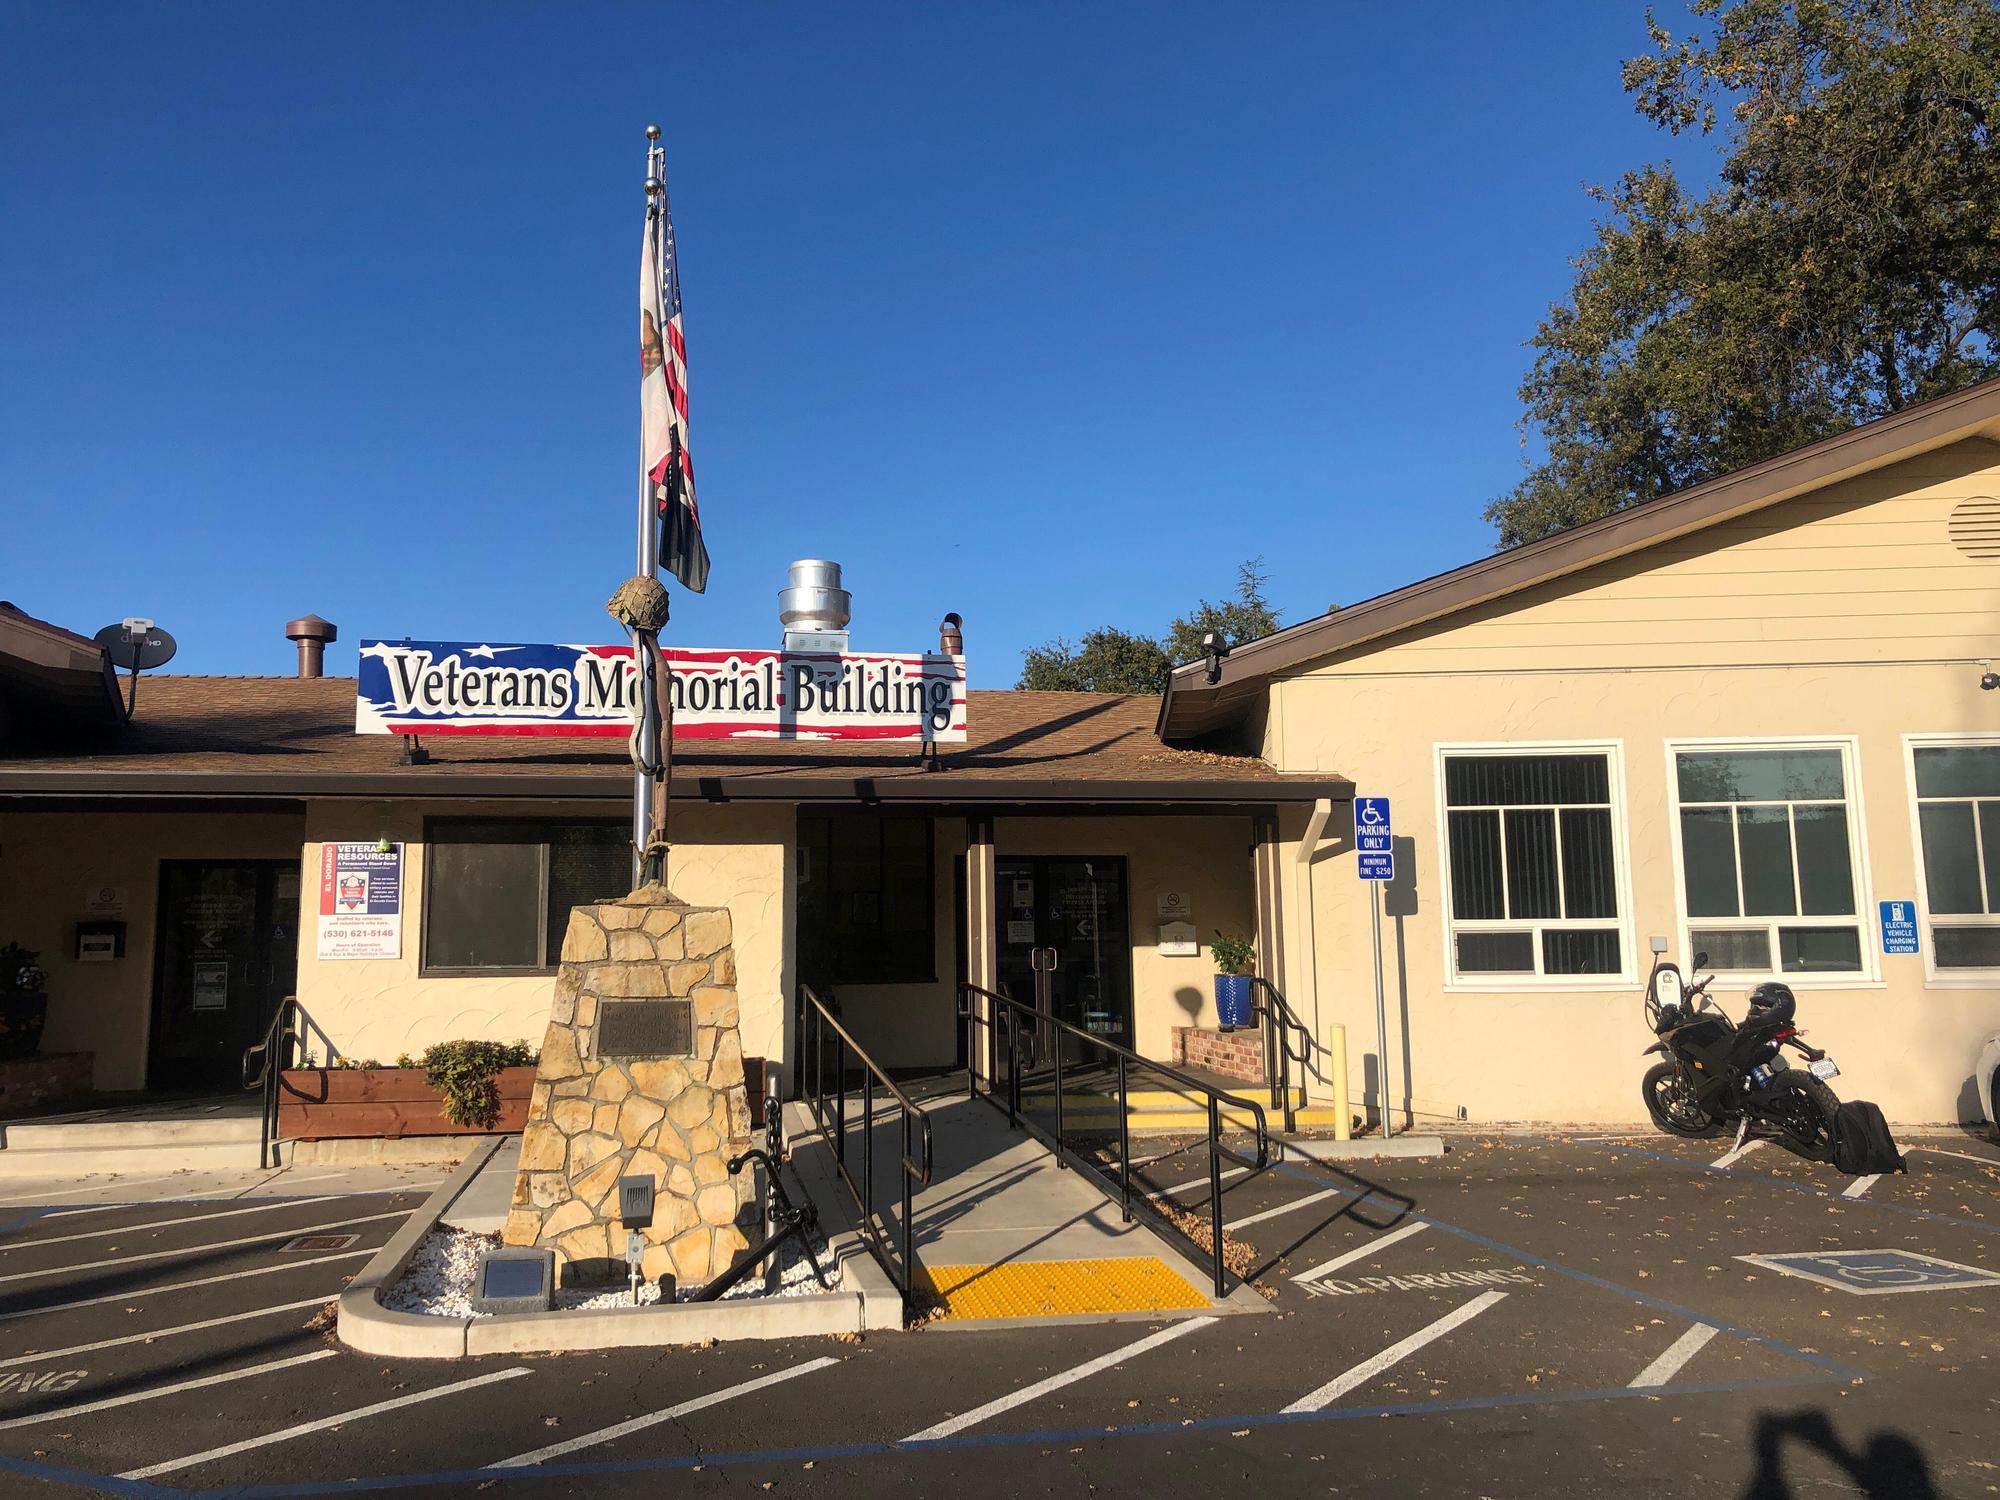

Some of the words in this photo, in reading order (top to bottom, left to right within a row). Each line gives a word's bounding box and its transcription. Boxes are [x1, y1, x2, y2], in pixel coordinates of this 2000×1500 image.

[394, 655, 569, 707] Veterans
[585, 659, 775, 711] Morial
[790, 663, 951, 731] Building
[1357, 825, 1390, 836] PARKING
[1364, 837, 1384, 849] ONLY
[337, 853, 398, 861] RESOURCES
[325, 846, 333, 881] DORADO
[1363, 858, 1387, 866] MINIMUM
[1360, 867, 1372, 875] FINE
[1375, 867, 1391, 875] $250
[324, 883, 332, 892] EL
[1885, 921, 1914, 929] ELECTRIC
[323, 930, 348, 940] (530)
[1887, 929, 1913, 937] VEHICLE
[1885, 937, 1916, 945] CHARGING
[1889, 945, 1914, 953] STATION
[1293, 1279, 1359, 1297] NO
[1358, 1268, 1534, 1292] PARKING
[0, 1370, 88, 1393] ING
